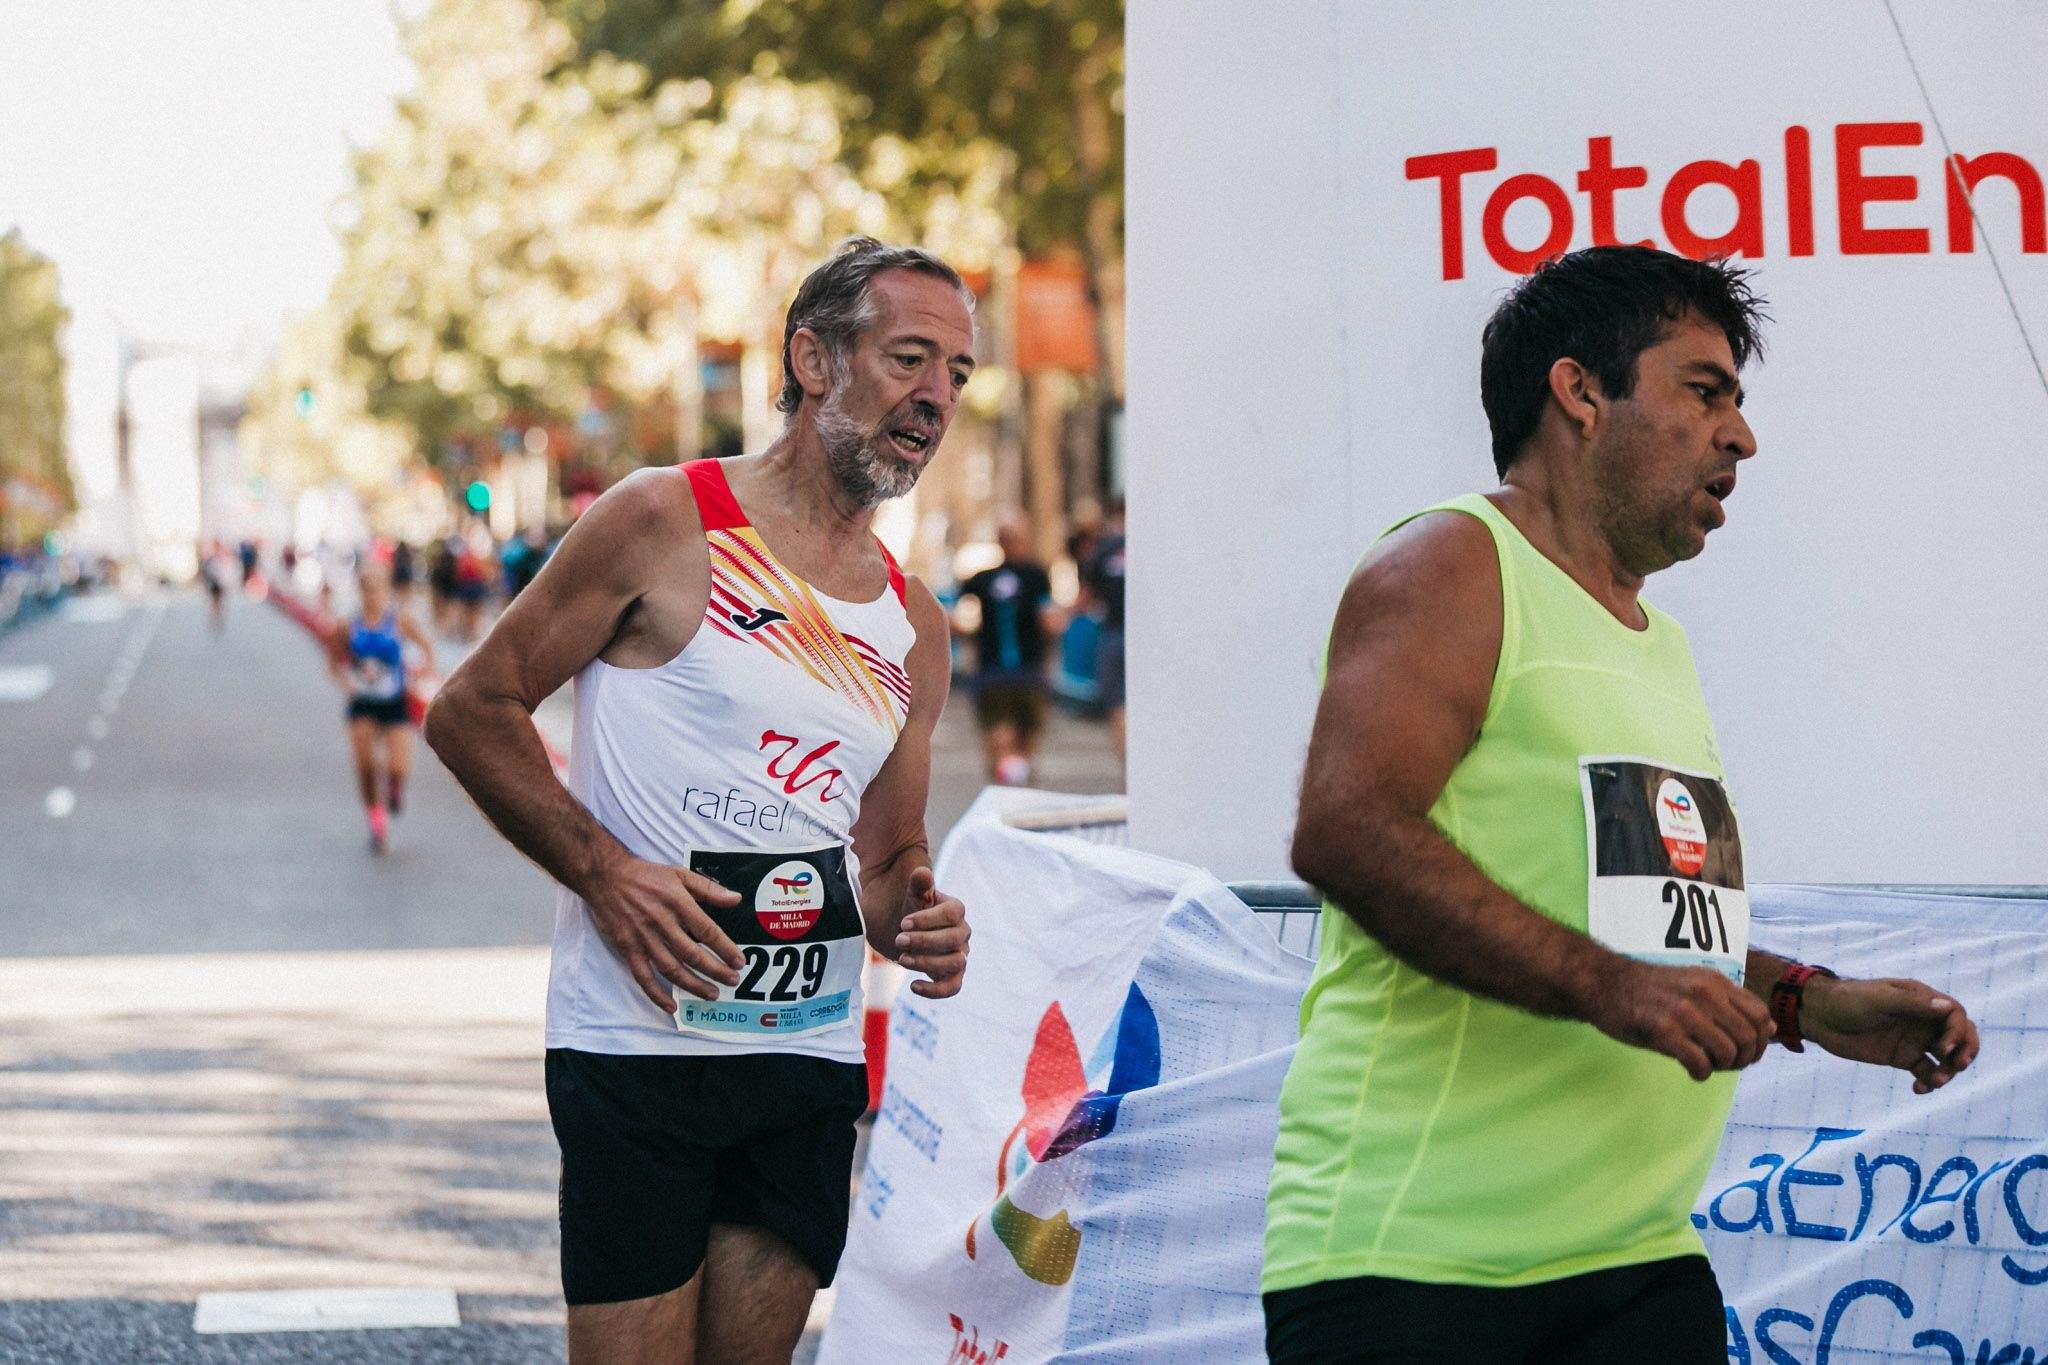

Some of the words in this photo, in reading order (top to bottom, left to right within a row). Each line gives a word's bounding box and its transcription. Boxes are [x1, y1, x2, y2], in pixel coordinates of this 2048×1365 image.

[1405, 121, 2048, 281] TotalEn
[770, 922, 780, 930] DE
[782, 920, 810, 929] MADRID
[771, 898, 811, 907] TotalEnergies
[1662, 880, 1729, 954] 201
[734, 943, 828, 1002] 229
[700, 1011, 748, 1023] MADRID
[1690, 1126, 2048, 1285] aEnerg
